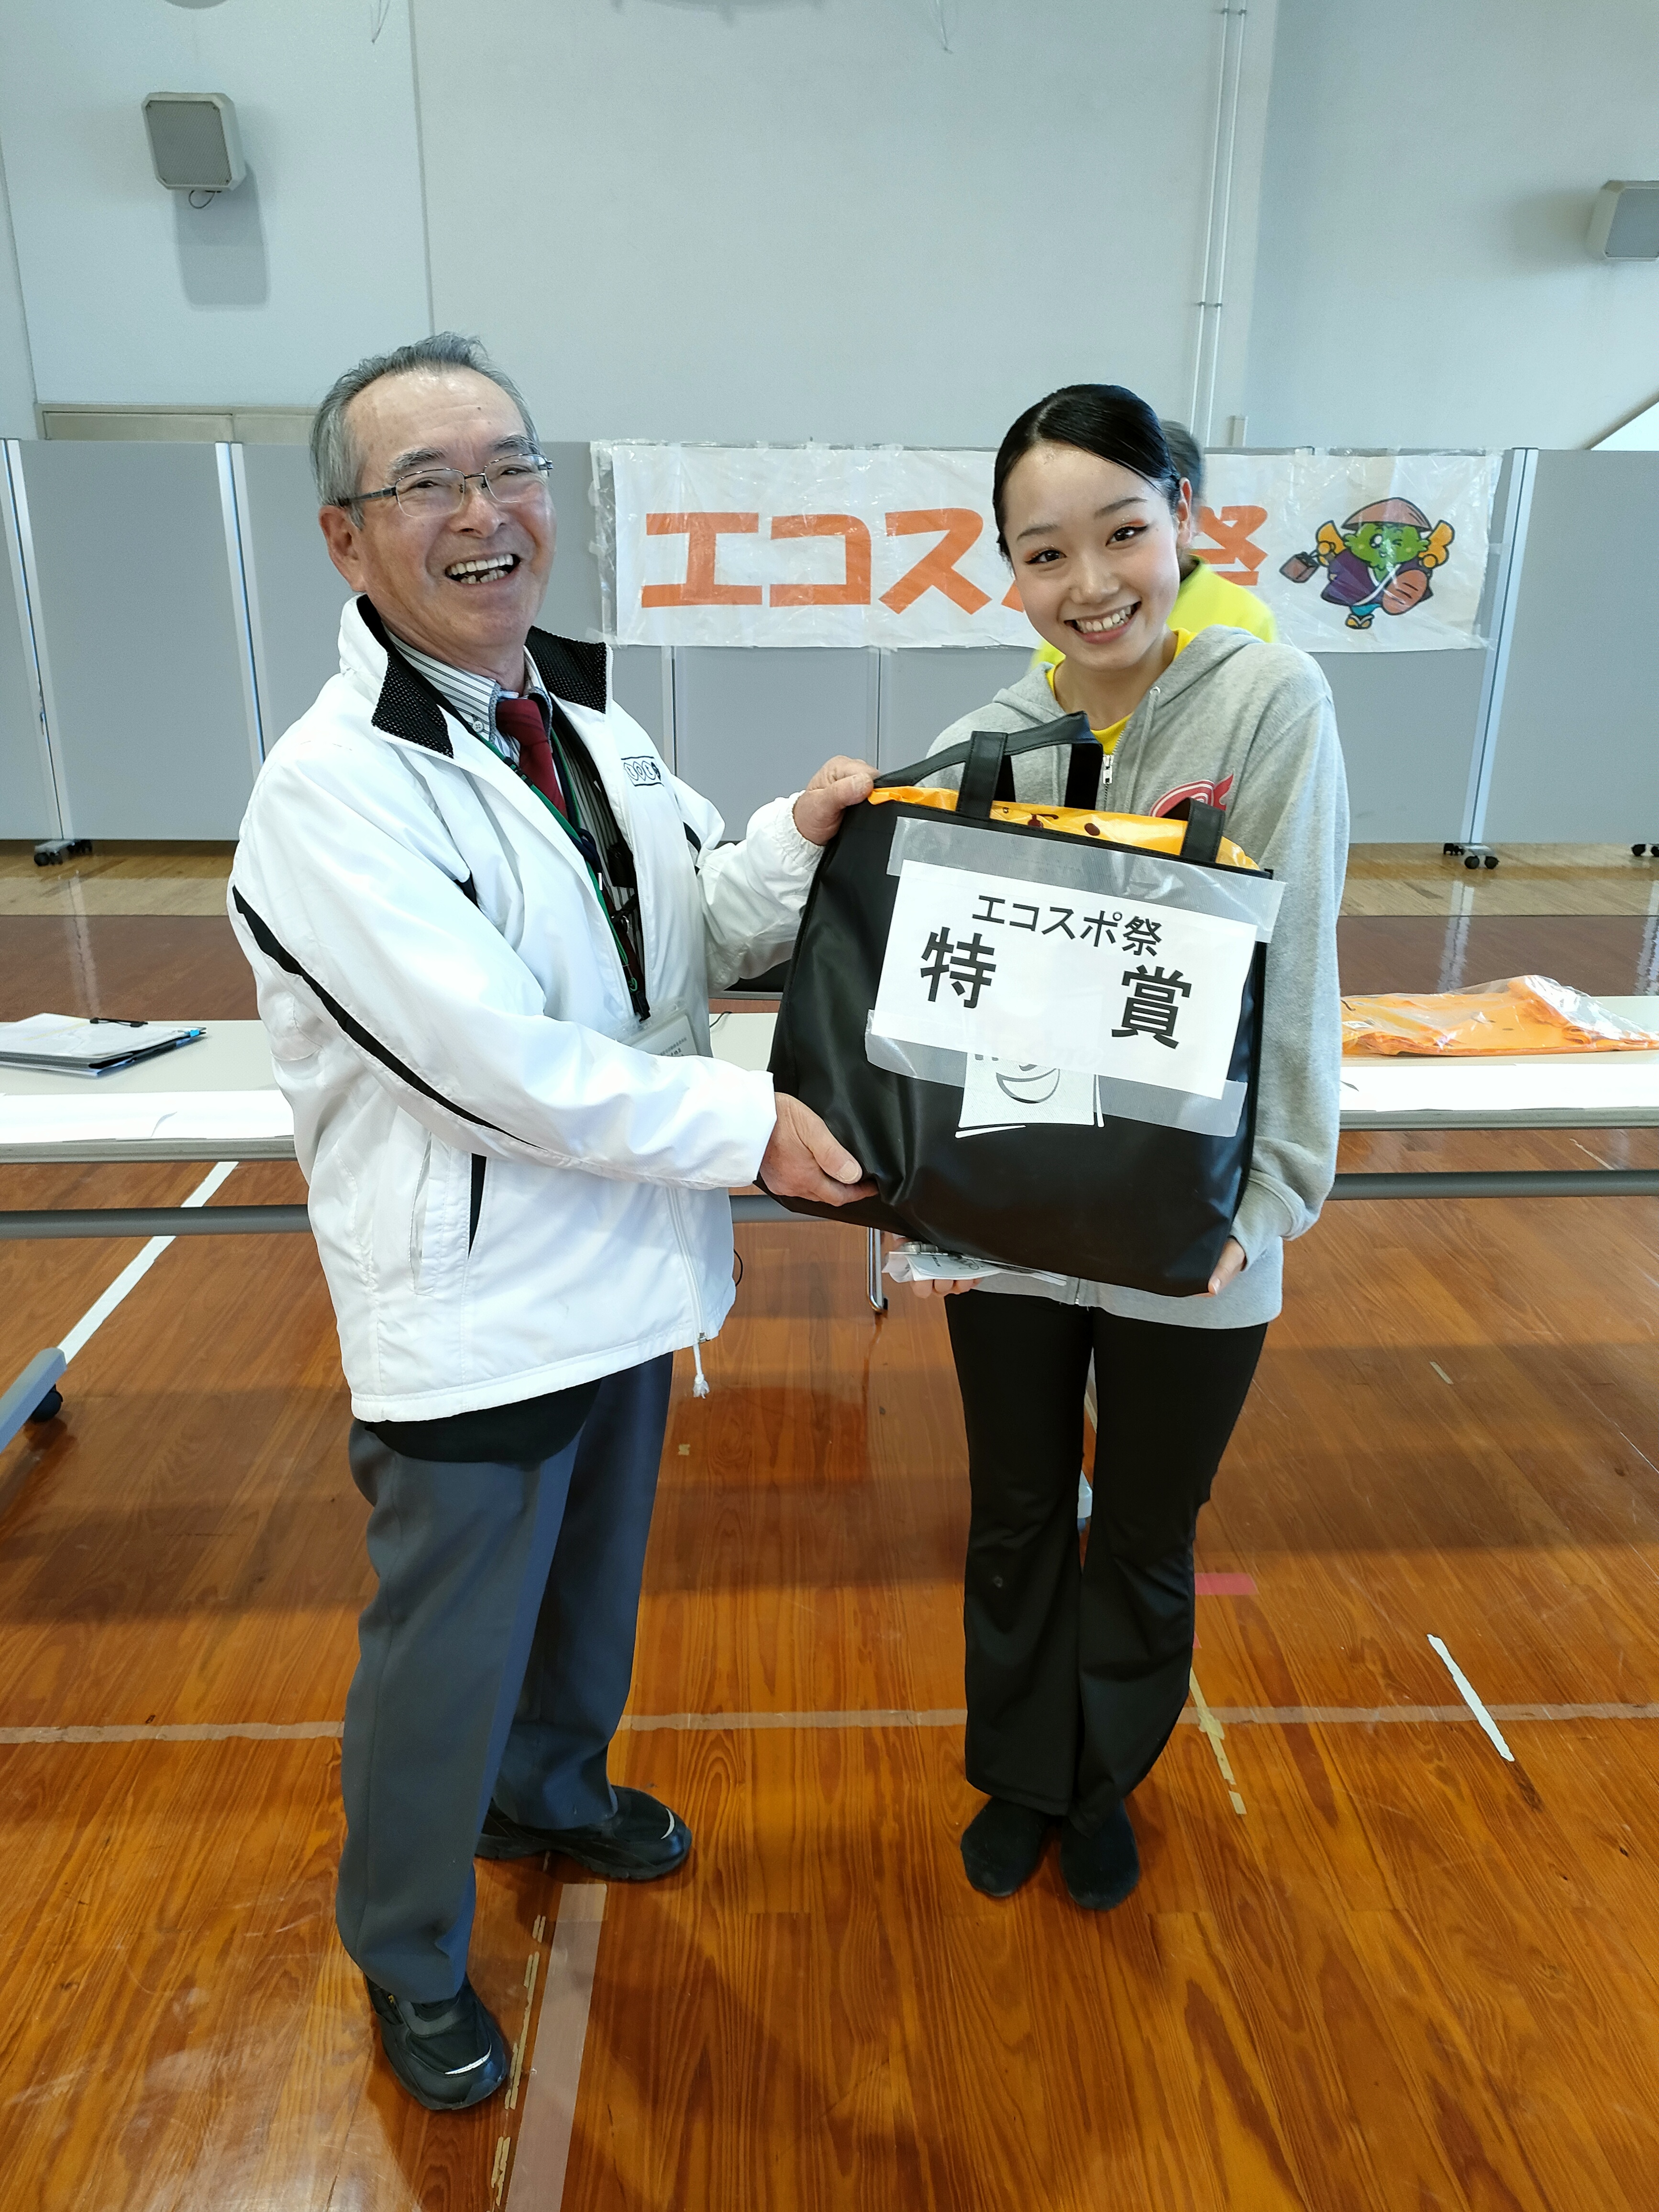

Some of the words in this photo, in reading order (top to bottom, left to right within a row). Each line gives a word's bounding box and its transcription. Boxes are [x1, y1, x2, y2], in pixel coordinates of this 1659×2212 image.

[641, 505, 1269, 615] エコス
[972, 895, 1162, 956] エコスポ祭
